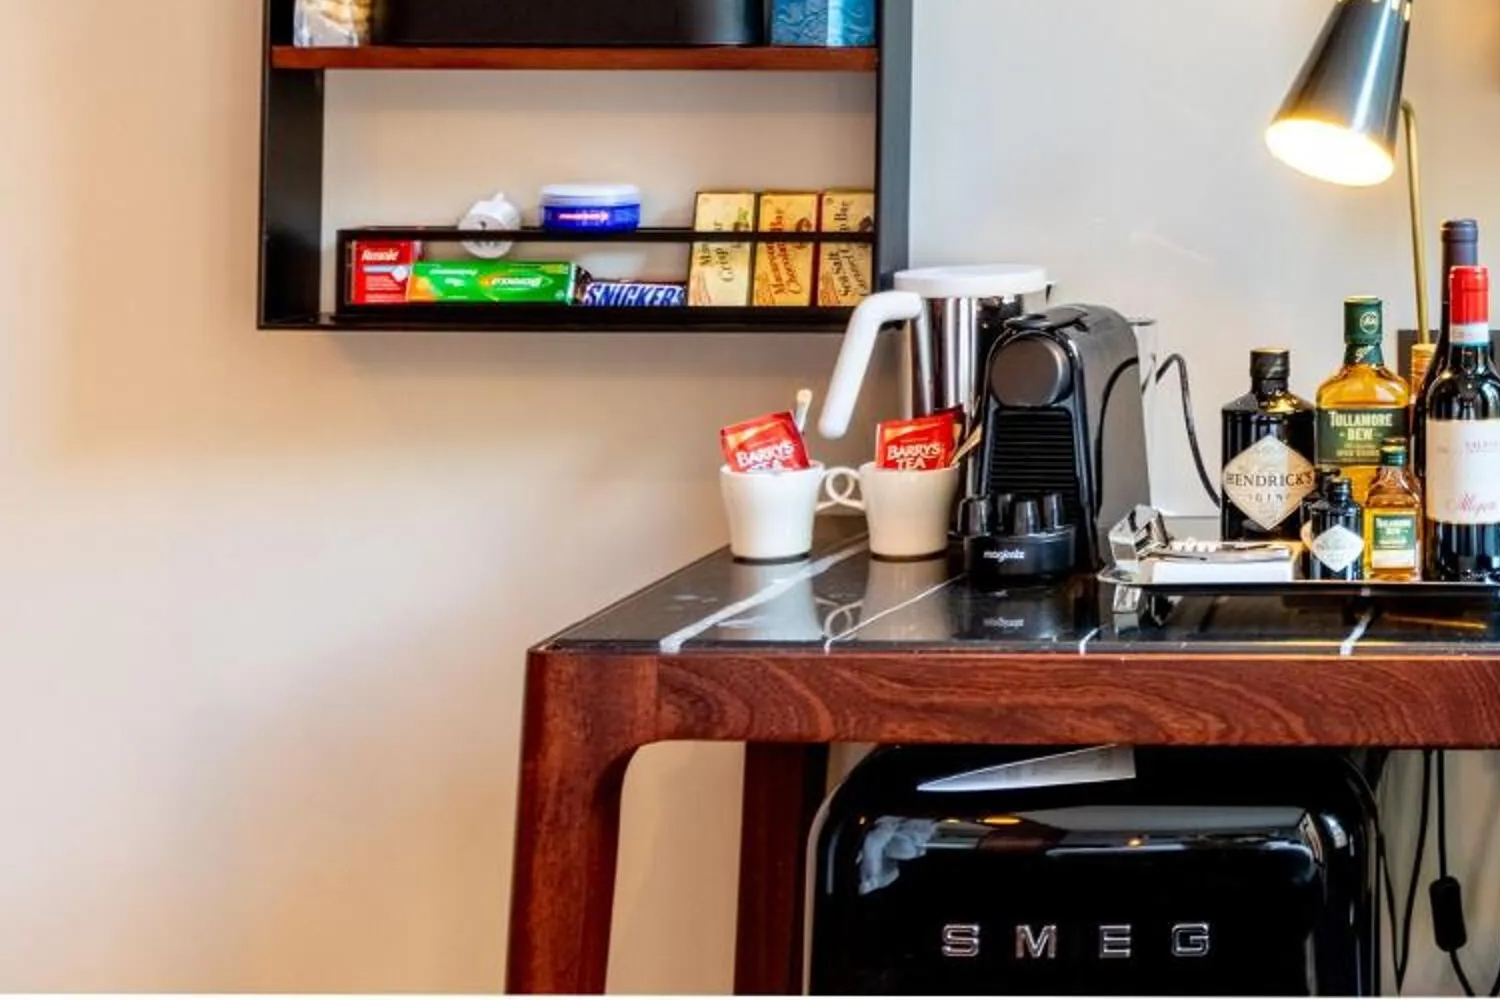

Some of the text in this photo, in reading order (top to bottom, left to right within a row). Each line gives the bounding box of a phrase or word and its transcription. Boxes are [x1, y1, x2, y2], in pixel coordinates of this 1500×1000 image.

[1328, 411, 1393, 427] TULLAMORE
[896, 457, 926, 471] TEA
[941, 922, 1211, 958] SMEG
